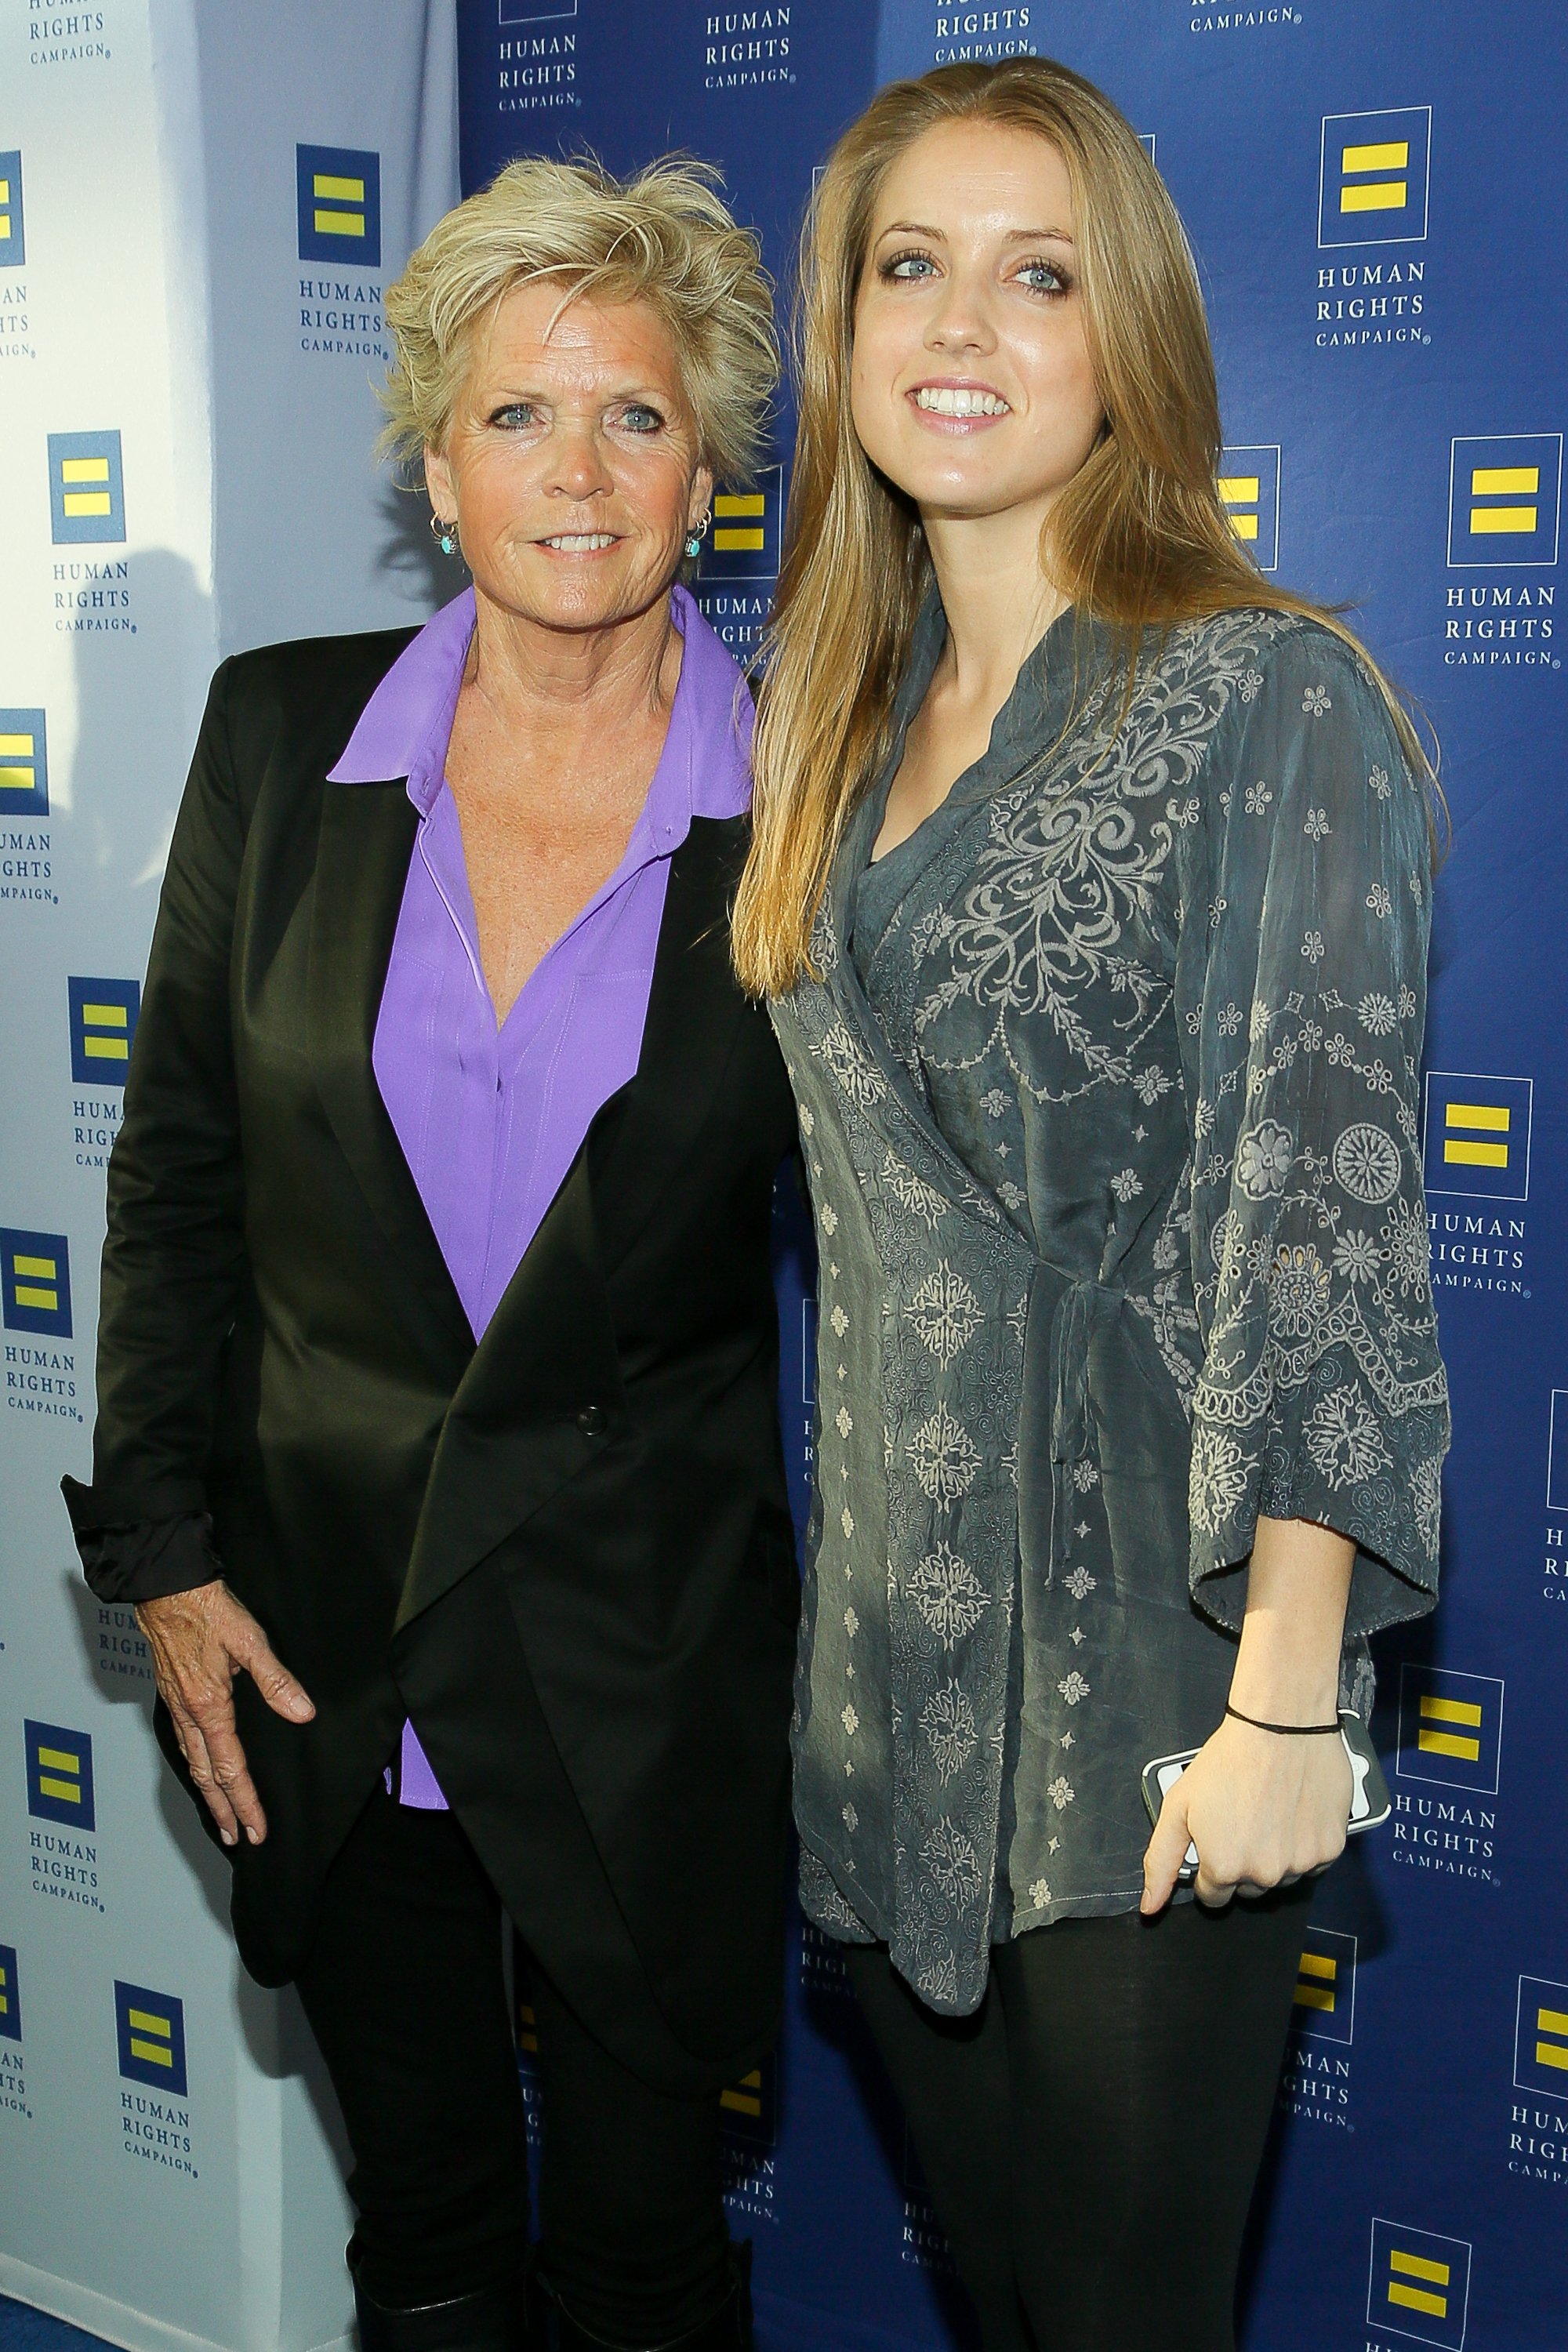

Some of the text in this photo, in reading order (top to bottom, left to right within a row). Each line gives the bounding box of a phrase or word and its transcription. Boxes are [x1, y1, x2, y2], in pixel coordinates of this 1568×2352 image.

[31, 13, 103, 39] RIGHTS
[707, 8, 789, 34] HUMAN
[937, 8, 1029, 37] RIGHTS
[501, 34, 575, 59] HUMAN
[707, 38, 789, 64] RIGHTS
[500, 64, 575, 88] RIGHTS
[1318, 263, 1424, 288] HUMAN
[300, 281, 380, 303] HUMAN
[1317, 296, 1422, 320] RIGHTS
[301, 310, 380, 332] RIGHTS
[53, 562, 128, 580] HUMAN
[55, 590, 129, 608] RIGHTS
[1447, 587, 1555, 606] HUMAN
[1446, 619, 1552, 638] RIGHTS
[0, 834, 49, 850] UMAN
[3, 861, 50, 877] GHTS
[1, 887, 51, 899] MPAIGN
[73, 1101, 117, 1120] HUM
[74, 1127, 115, 1146] RIG
[1426, 1212, 1526, 1238] HUMAN
[1432, 1274, 1521, 1292] AMPAIGN
[5, 1346, 74, 1370] HUMAN
[7, 1372, 75, 1396] RIGHTS
[98, 1609, 140, 1631] HUM
[99, 1633, 147, 1657] RIGH
[100, 1659, 152, 1680] CAMPAI
[1396, 1795, 1495, 1828] HUMAN
[30, 1832, 96, 1863] HUMAN
[1395, 1823, 1493, 1857] RIGHTS
[32, 1857, 97, 1887] RIGHTS
[1283, 2075, 1348, 2104] GHTS
[121, 2092, 188, 2128] HUMAN
[1512, 2106, 1568, 2134] HUM
[123, 2118, 190, 2152] RIGHTS
[1510, 2134, 1567, 2161] RIG
[1508, 2161, 1563, 2183] CAMP
